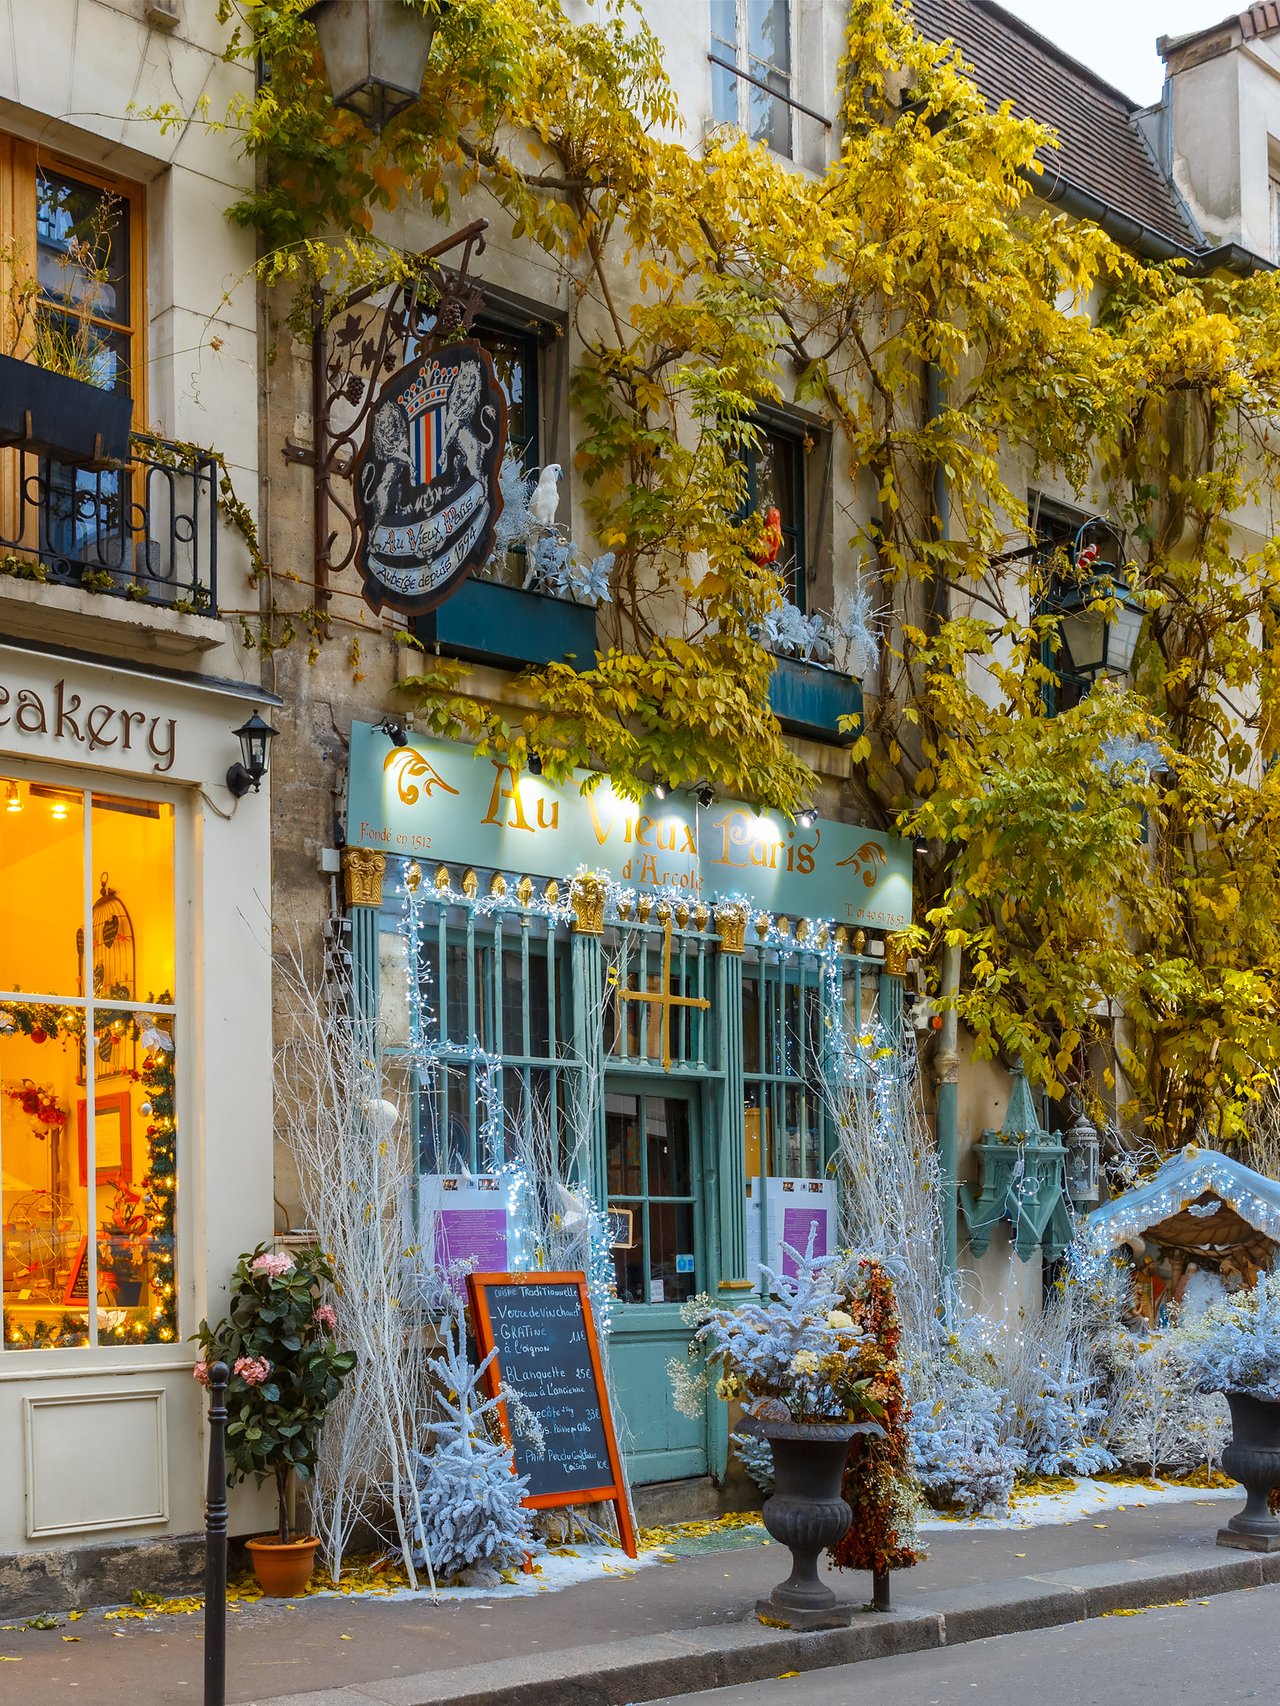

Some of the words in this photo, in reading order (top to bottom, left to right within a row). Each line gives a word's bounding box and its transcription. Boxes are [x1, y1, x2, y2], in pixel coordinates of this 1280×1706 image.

[381, 529, 405, 554] Au
[406, 521, 442, 551] Vieux
[441, 495, 473, 534] Paris
[376, 567, 417, 593] Auberge
[417, 557, 452, 588] depuis
[454, 525, 478, 563] 1594
[480, 759, 559, 833] Au
[566, 774, 698, 855] Vieux
[710, 807, 821, 875] Paris
[358, 821, 392, 843] Fondé
[396, 831, 409, 847] en
[411, 833, 432, 850] 1512
[622, 852, 703, 890] d'Arcole
[867, 910, 876, 922] 40
[504, 1342, 512, 1354] à
[575, 1367, 592, 1380] 25€
